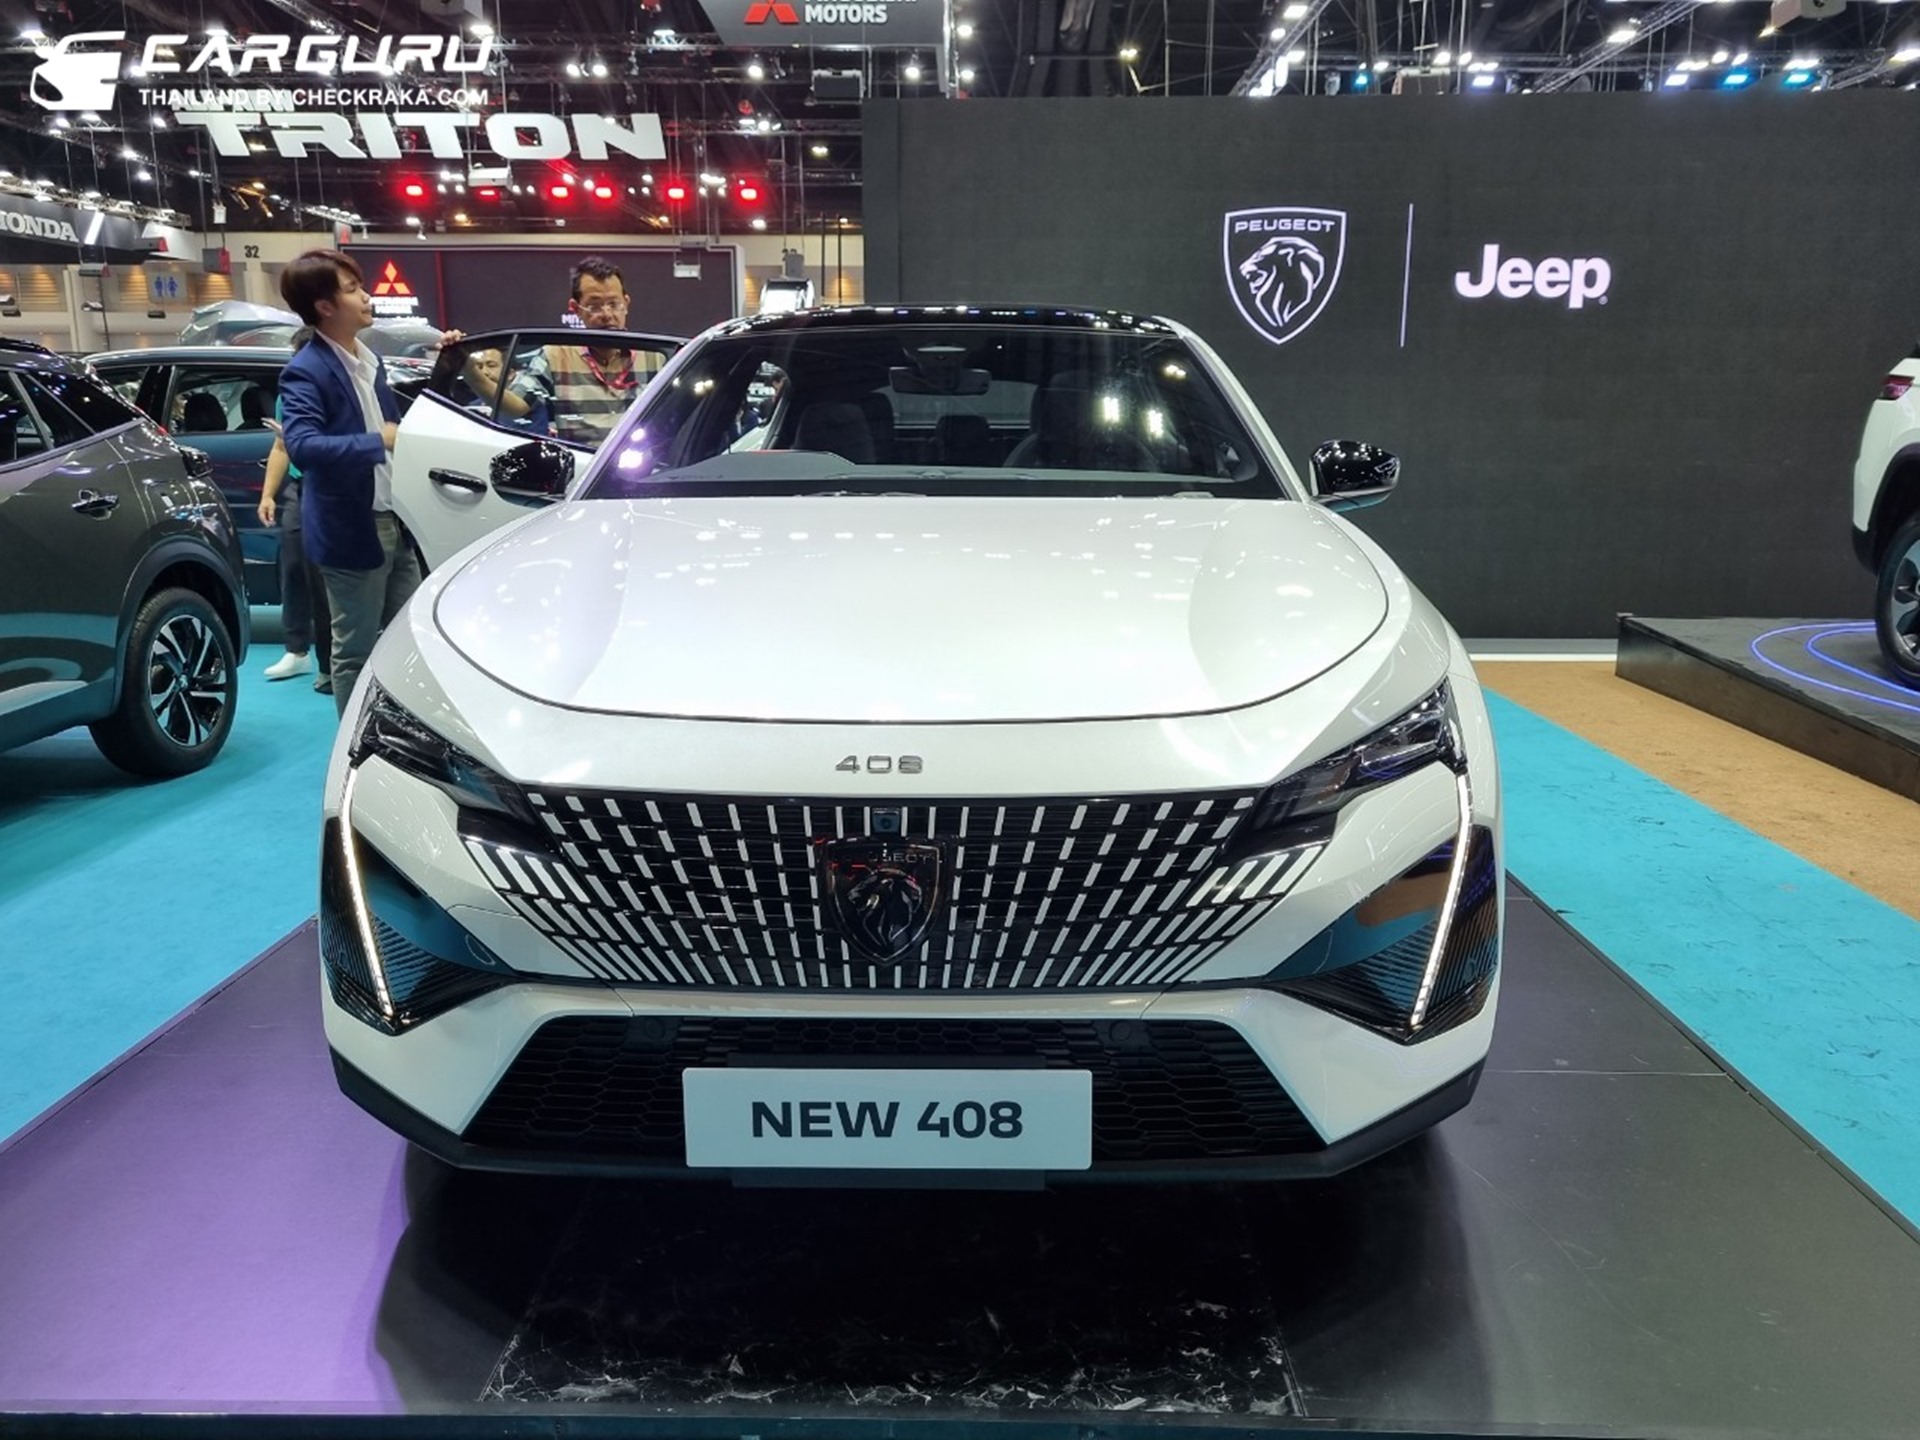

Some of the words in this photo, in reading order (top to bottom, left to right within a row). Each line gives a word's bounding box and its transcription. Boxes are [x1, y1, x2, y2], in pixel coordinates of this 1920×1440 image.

[804, 4, 888, 24] MOTORS
[173, 111, 667, 160] TRITON
[1235, 218, 1336, 234] PEUGEOT
[243, 244, 261, 259] 32
[1455, 243, 1612, 309] Jeep
[835, 755, 924, 774] 408
[751, 1101, 900, 1138] NEW
[917, 1100, 1023, 1139] 408
